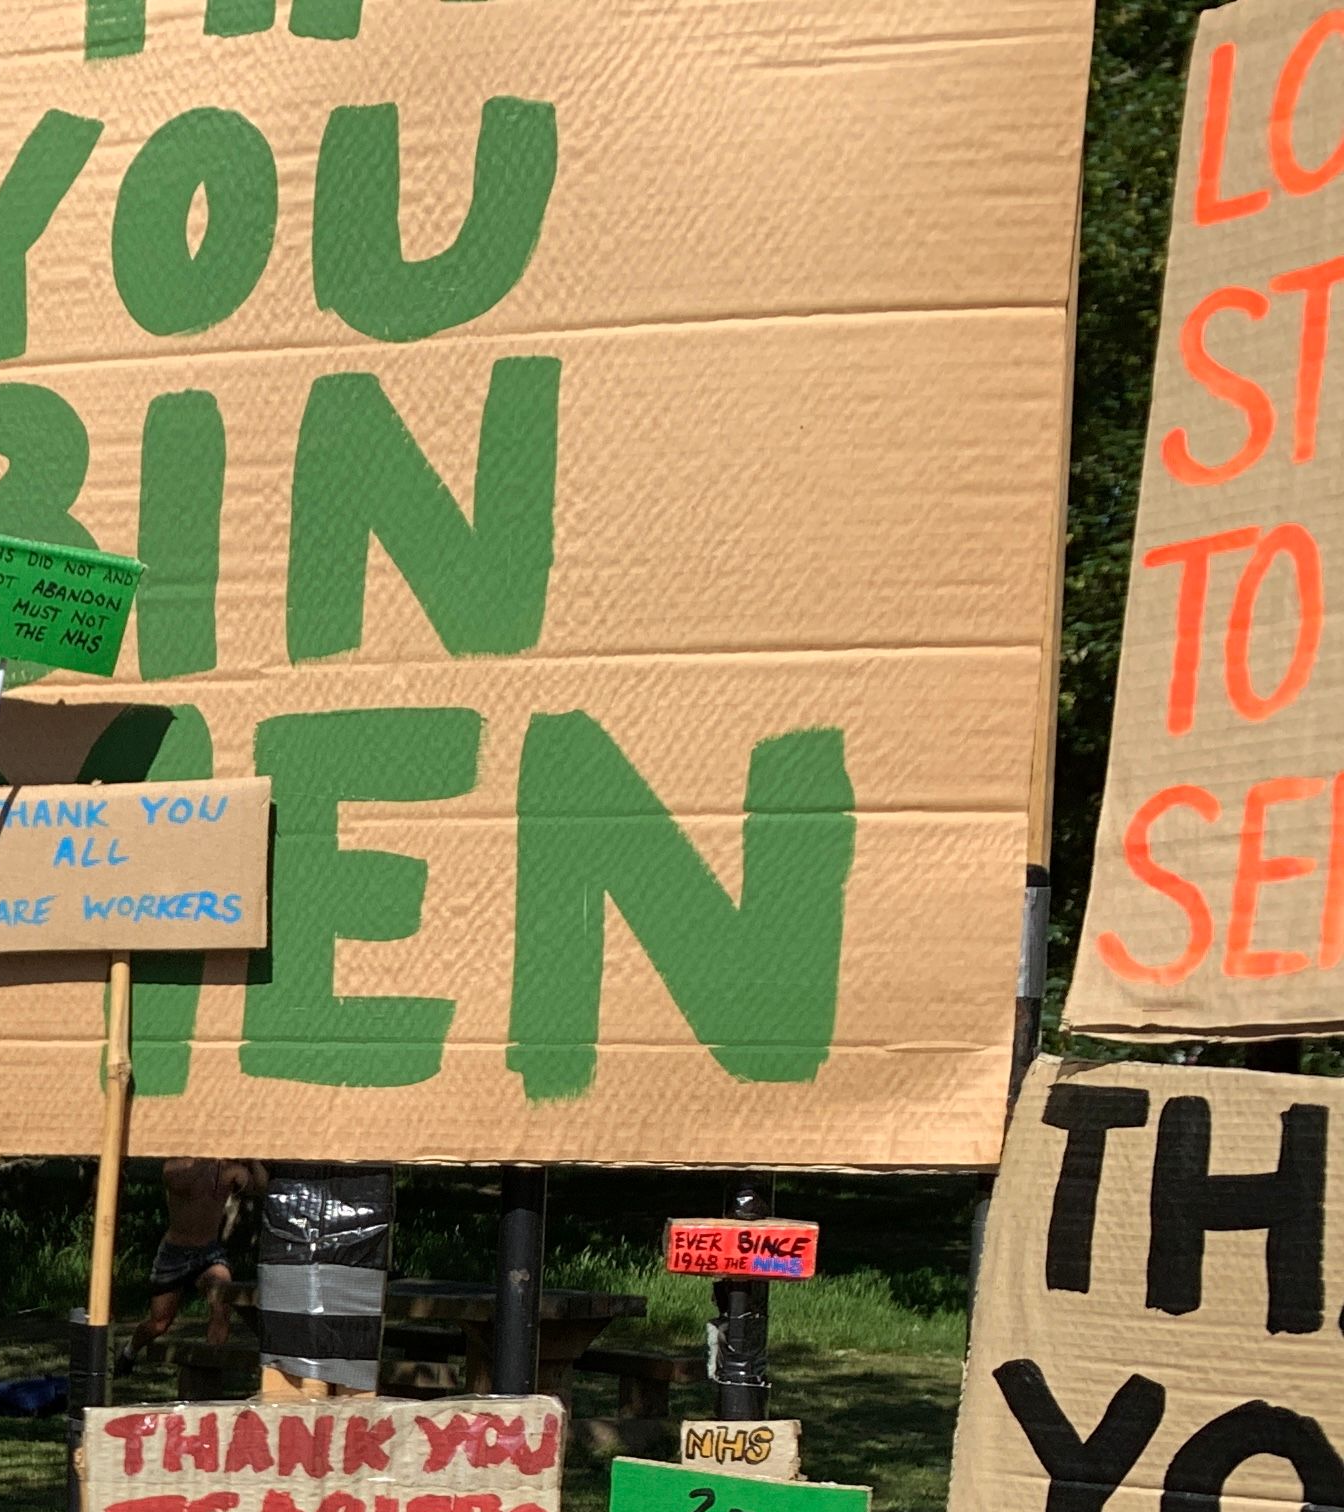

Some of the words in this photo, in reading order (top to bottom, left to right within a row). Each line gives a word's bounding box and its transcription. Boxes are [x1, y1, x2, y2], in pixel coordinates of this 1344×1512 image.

[27, 550, 54, 570] DID
[64, 558, 95, 579] NOT
[102, 566, 134, 588] AND
[31, 578, 122, 613] ABANDON
[12, 597, 62, 624] MUST
[70, 606, 110, 630] NOT
[1142, 520, 1324, 738] TO
[14, 620, 46, 643] THE
[59, 629, 103, 655] NHS
[140, 795, 229, 826] YOU
[53, 835, 130, 869] ALL
[82, 889, 243, 925] WORKERS
[675, 1231, 723, 1253] EVER
[724, 1256, 749, 1271] THE
[103, 1410, 395, 1477] THANK
[414, 1412, 561, 1476] YOU
[685, 1426, 773, 1467] NHS
